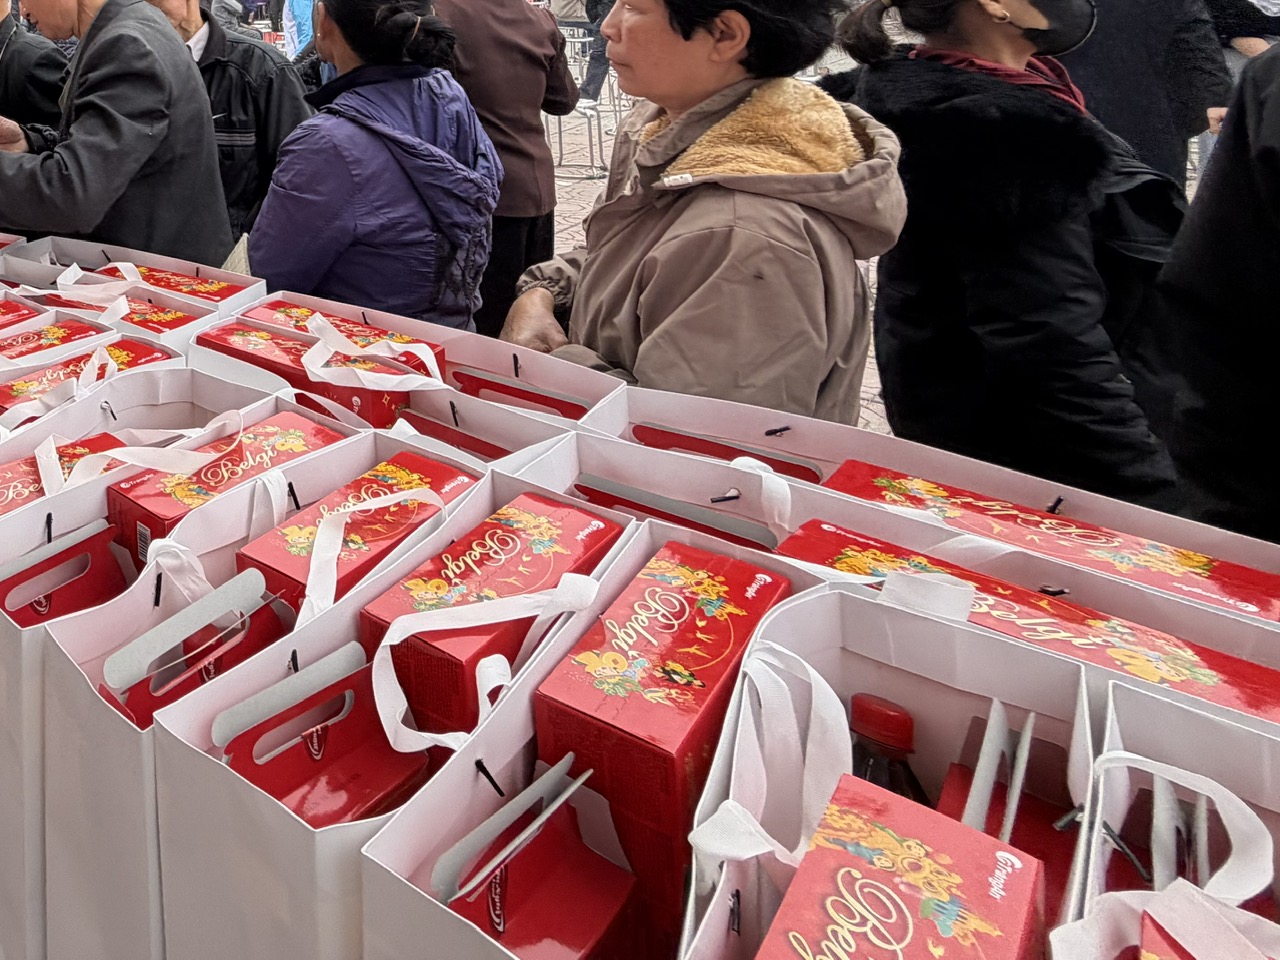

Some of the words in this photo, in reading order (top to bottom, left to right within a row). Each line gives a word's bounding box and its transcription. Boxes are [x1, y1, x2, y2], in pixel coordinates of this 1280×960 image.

[201, 446, 277, 486] Belgi
[440, 529, 520, 579] Belgi
[605, 587, 690, 652] Belgi
